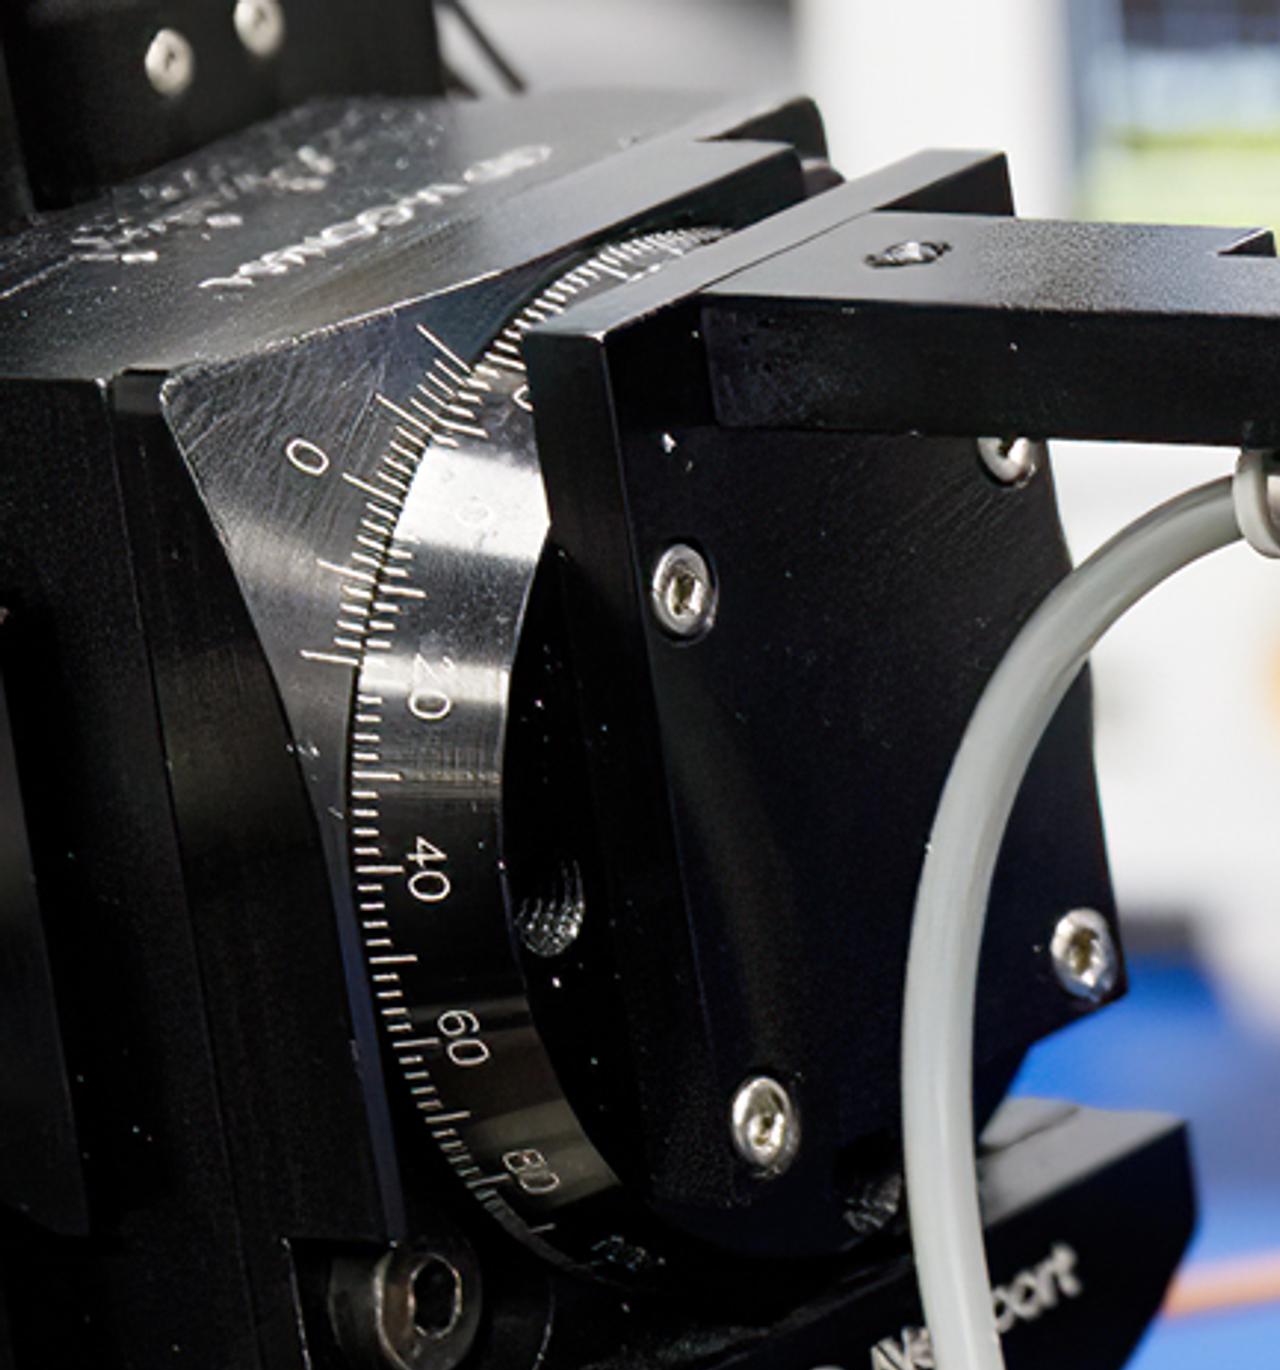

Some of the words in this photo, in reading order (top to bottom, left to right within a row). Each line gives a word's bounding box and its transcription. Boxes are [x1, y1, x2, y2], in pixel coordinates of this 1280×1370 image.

[286, 437, 330, 477] 0
[408, 652, 456, 720] 20
[405, 836, 451, 902] 40
[437, 1009, 490, 1066] 60
